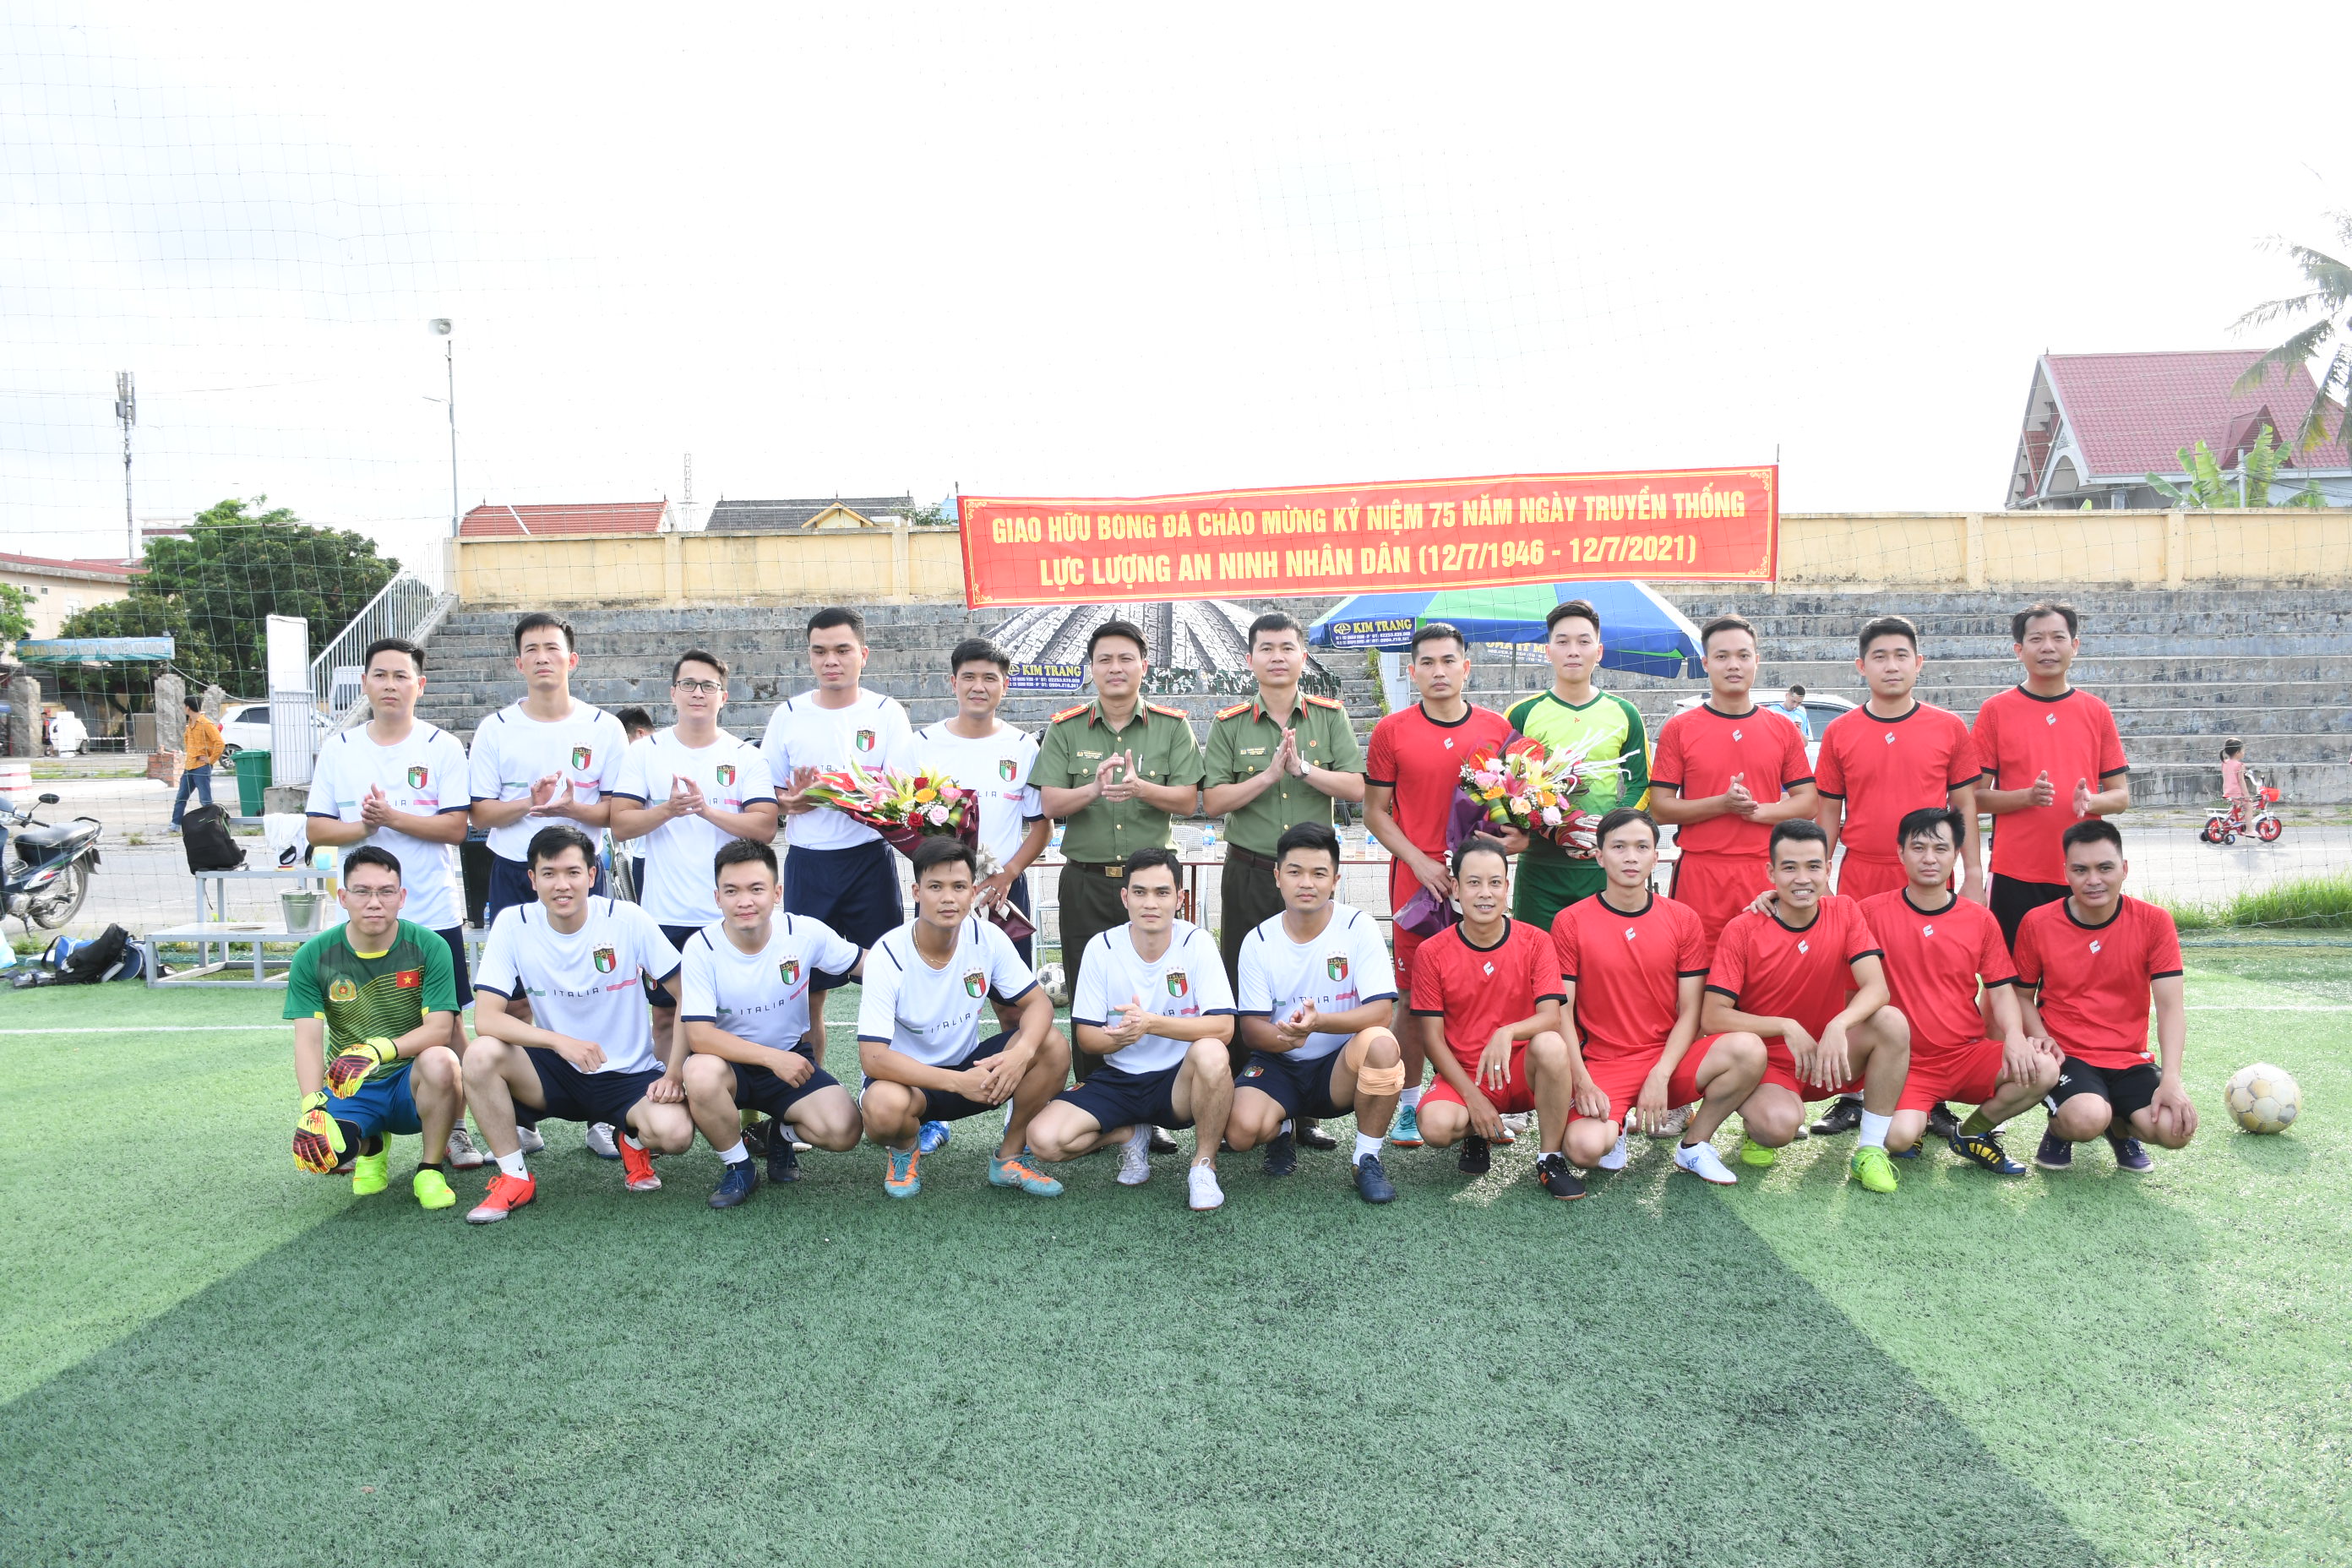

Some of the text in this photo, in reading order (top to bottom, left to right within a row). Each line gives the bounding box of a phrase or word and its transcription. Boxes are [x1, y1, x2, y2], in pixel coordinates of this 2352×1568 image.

[992, 517, 1042, 543] GIAO
[1048, 512, 1091, 542] HỮU
[1162, 510, 1192, 538] ĐÁ
[1198, 507, 1255, 536] CHÀO
[1262, 504, 1326, 535] MỪNG
[1333, 498, 1360, 532] KỶ
[1367, 498, 1423, 535] NIỆM
[1429, 502, 1456, 528] 75
[1462, 493, 1512, 526] NĂM
[1520, 491, 1576, 523] NGÀY
[1583, 485, 1666, 521] TRUYỀN
[1673, 482, 1745, 519] THỐNG
[1040, 556, 1085, 591] LỰC
[1092, 553, 1171, 589] LƯỢNG
[1179, 553, 1211, 581] AN
[1219, 551, 1278, 580] NINH
[1286, 542, 1353, 577] NHÂN
[1361, 542, 1410, 574] DÂN
[1418, 539, 1544, 575] (12/7/1946
[1569, 535, 1696, 564] 12/7/2021)
[1353, 618, 1413, 634] KIM TRANG
[1022, 664, 1081, 677] KIM TRANG
[781, 961, 798, 970] ITALIA
[965, 973, 983, 982] ITALIA
[554, 987, 599, 998] ITALIA
[740, 999, 785, 1015] ITALIA
[931, 1012, 971, 1033] ITALIA
